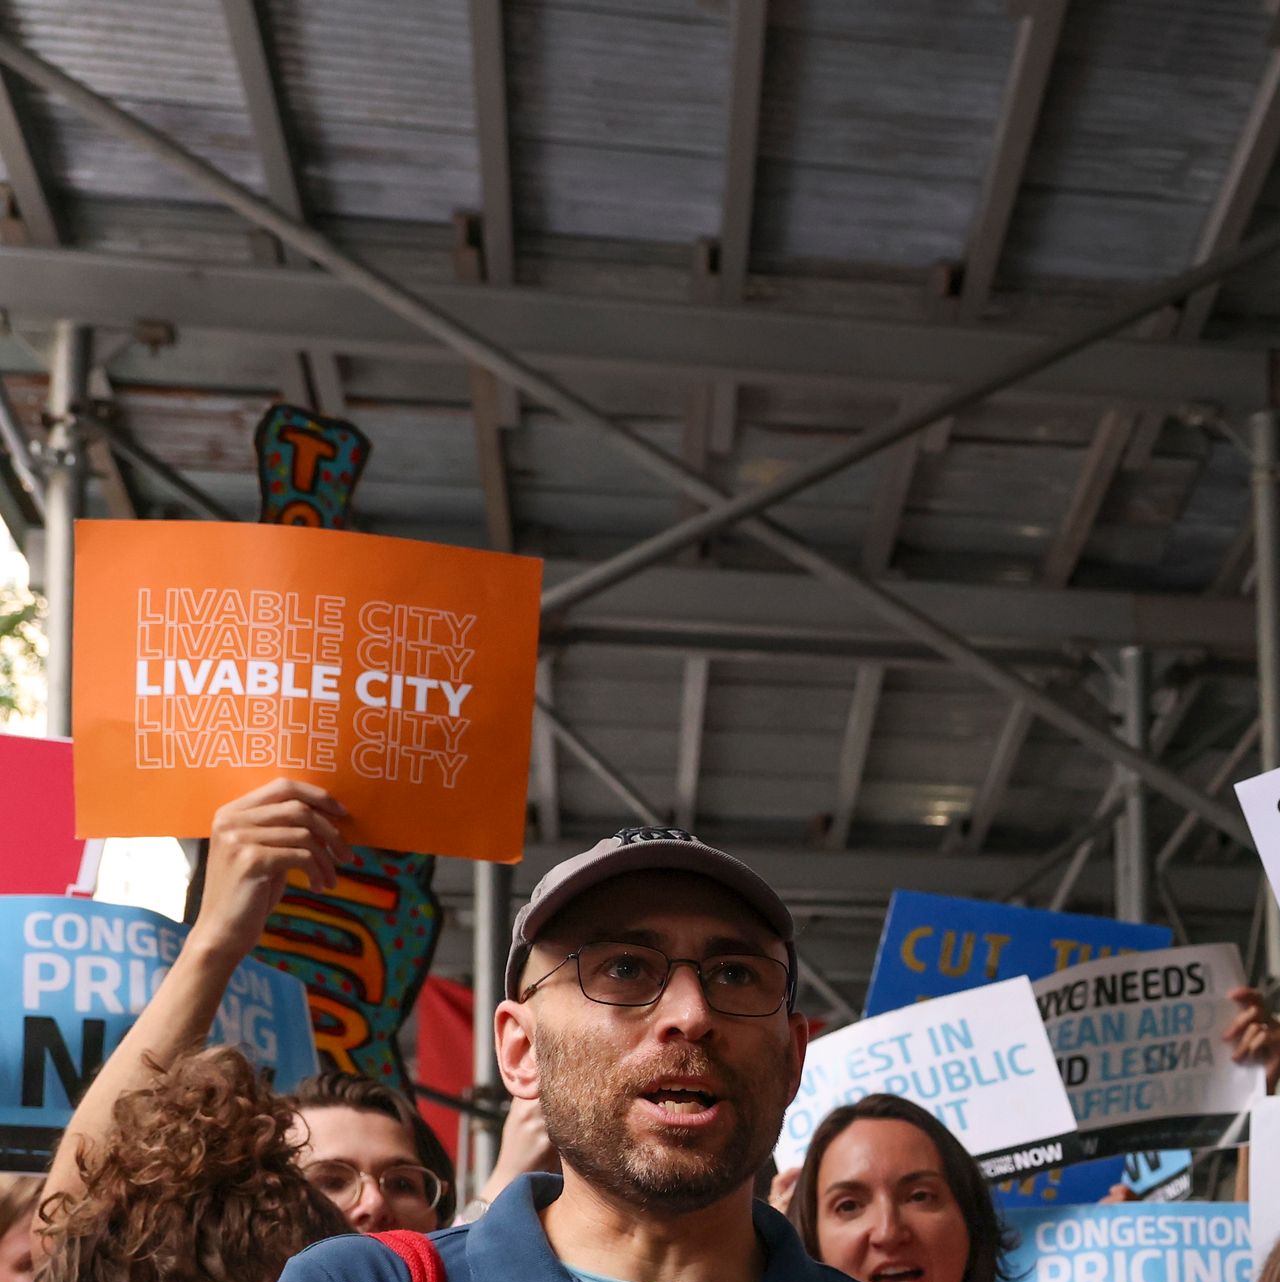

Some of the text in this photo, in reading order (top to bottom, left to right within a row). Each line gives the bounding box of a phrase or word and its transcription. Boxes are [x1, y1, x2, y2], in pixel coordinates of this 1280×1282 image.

[137, 588, 477, 649] LIVABLE CITY
[136, 623, 475, 683] LIVABLE CITY
[136, 659, 473, 718] LIVABLE CITY
[135, 695, 472, 753] LIVABLE CITY
[135, 730, 468, 789] LIVABLE CITY
[902, 927, 1011, 978] CUT
[1095, 963, 1206, 1009] NEEDS
[927, 1019, 974, 1056] IN
[1138, 1003, 1197, 1041] AIR
[884, 1044, 1035, 1101] PUBLIC
[1014, 1142, 1063, 1171] NOW
[1036, 1216, 1251, 1251] CONGESTION
